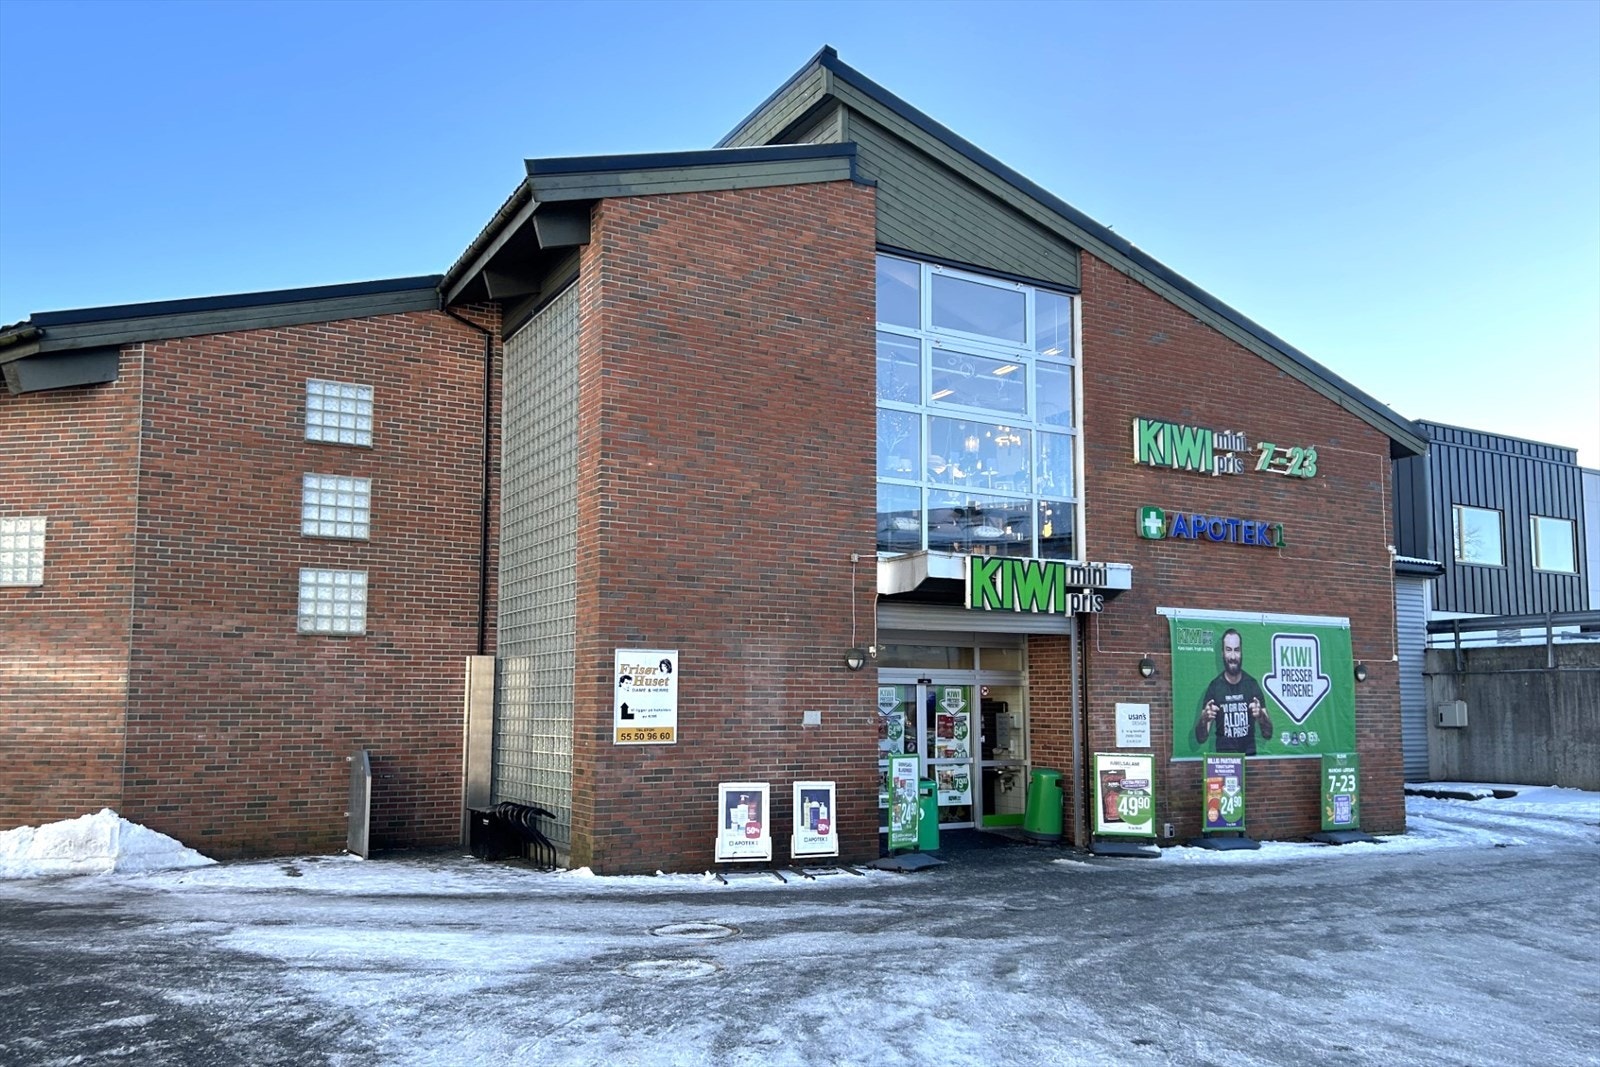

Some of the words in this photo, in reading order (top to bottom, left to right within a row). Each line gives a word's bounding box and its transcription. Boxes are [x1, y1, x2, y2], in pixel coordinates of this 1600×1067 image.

[1136, 417, 1214, 474] KIWI
[1216, 432, 1248, 451] mini
[1216, 453, 1245, 476] pris
[1256, 441, 1318, 479] 7-23
[1170, 512, 1272, 547] APOTEK
[1273, 523, 1287, 548] 1
[970, 555, 1067, 614] KIWI
[1070, 562, 1108, 586] mini
[1070, 589, 1104, 618] pris
[1280, 646, 1312, 667] KIWI
[632, 675, 670, 687] Huset
[1281, 669, 1313, 683] PRESSER
[1281, 684, 1314, 698] PRISENE!
[1224, 711, 1249, 727] ALDRI
[621, 732, 632, 741] 55
[634, 732, 645, 741] 50
[647, 732, 658, 741] 96
[660, 732, 671, 741] 60
[1328, 775, 1356, 792] 7-23
